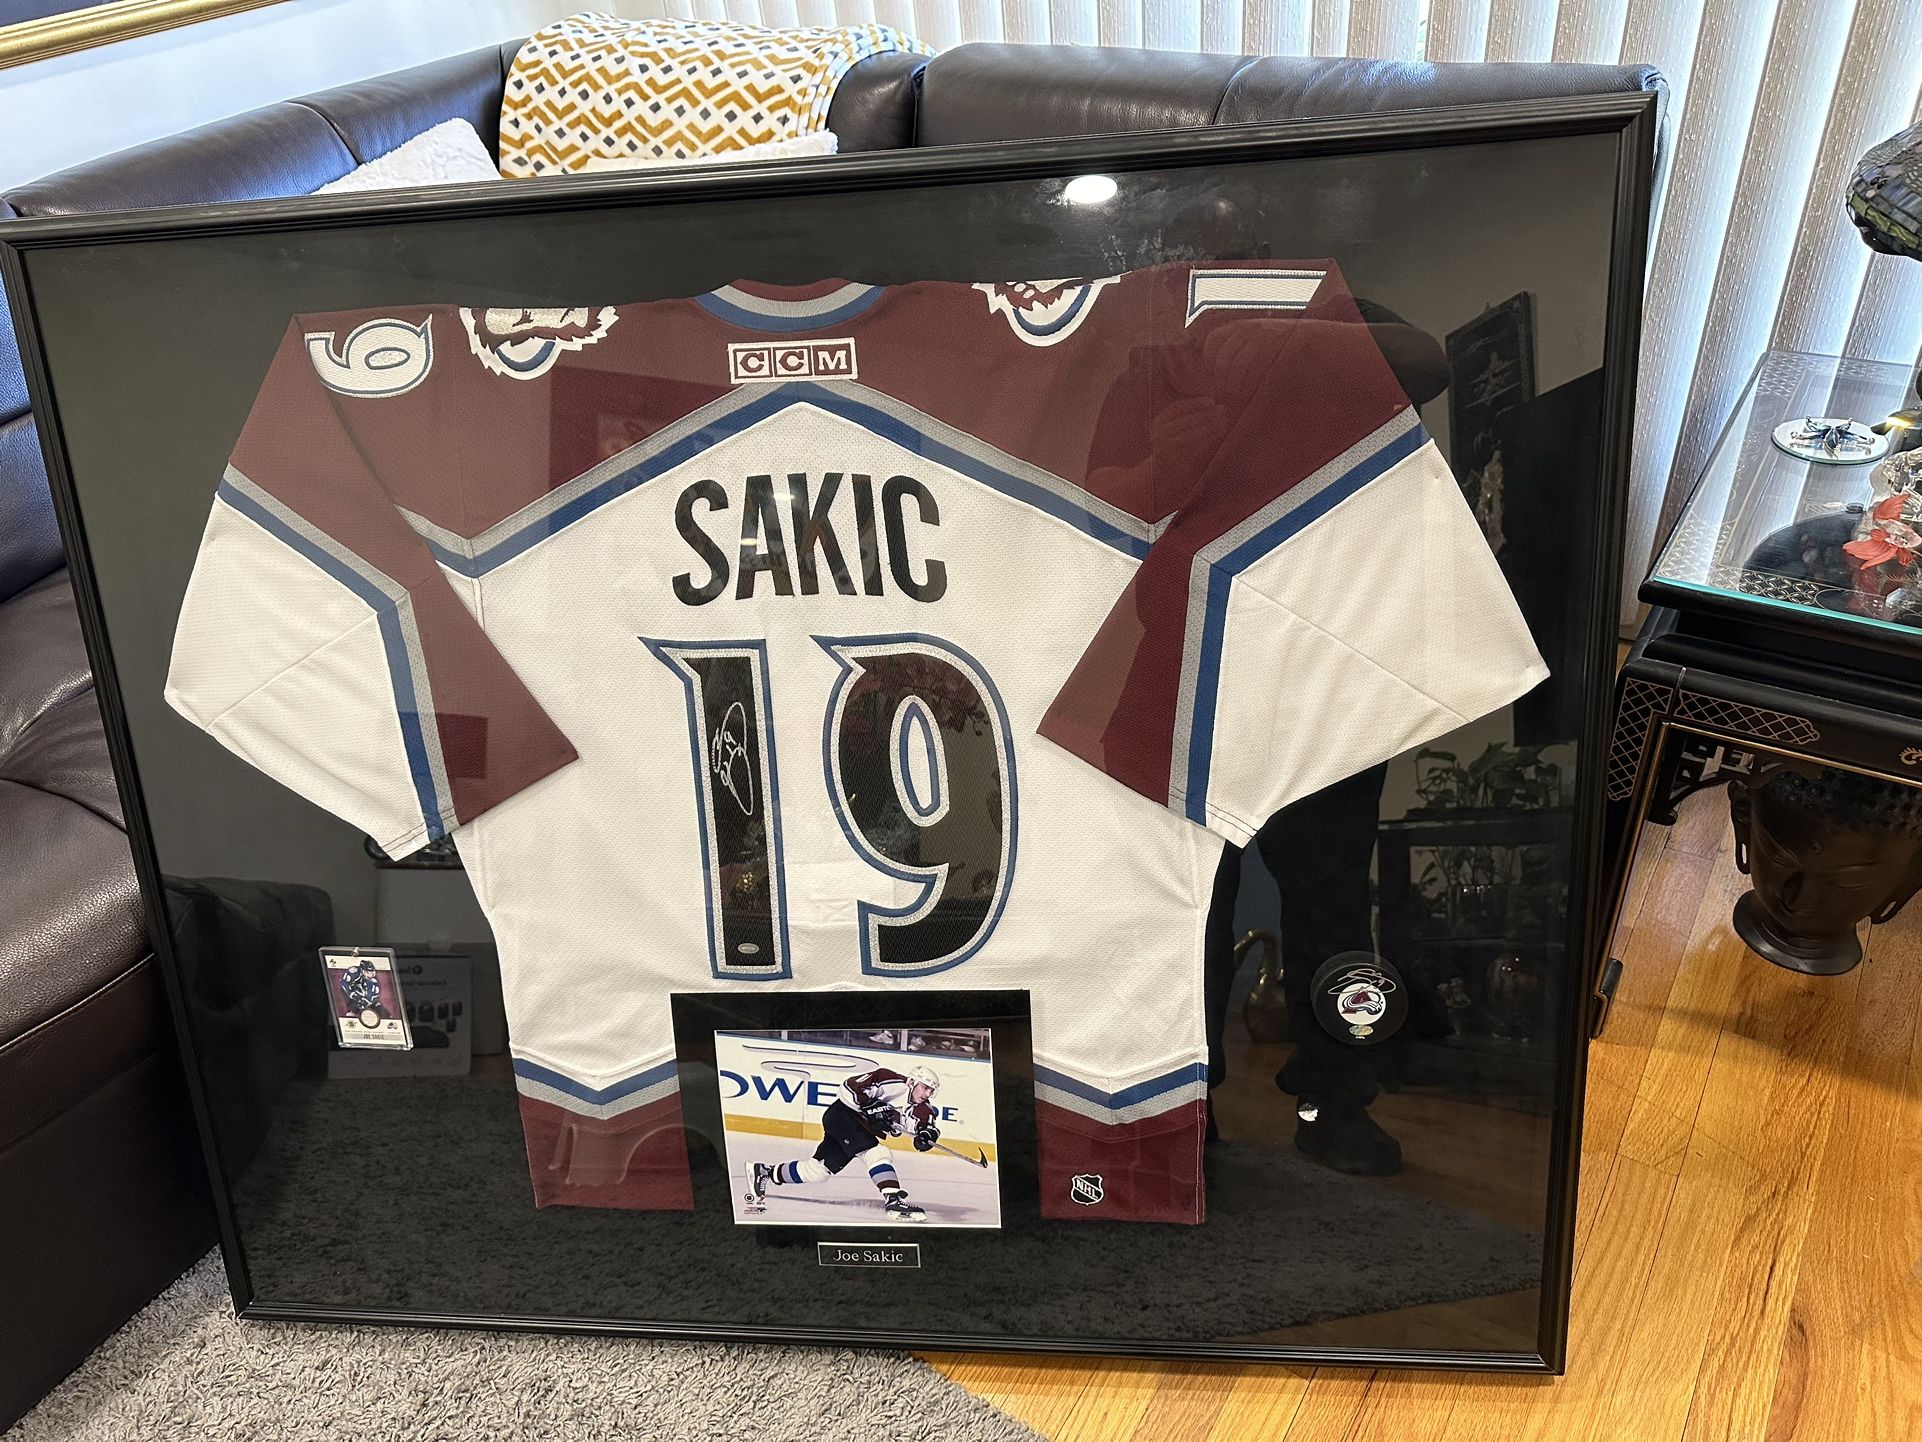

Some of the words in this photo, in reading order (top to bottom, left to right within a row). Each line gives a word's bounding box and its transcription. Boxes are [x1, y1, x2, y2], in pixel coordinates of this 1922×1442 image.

[738, 350, 849, 374] CCM
[672, 472, 948, 607] SAKIC
[637, 632, 1019, 979] 19
[1076, 1178, 1099, 1200] NHL
[832, 1249, 860, 1261] Joe
[863, 1250, 904, 1263] Sakic
